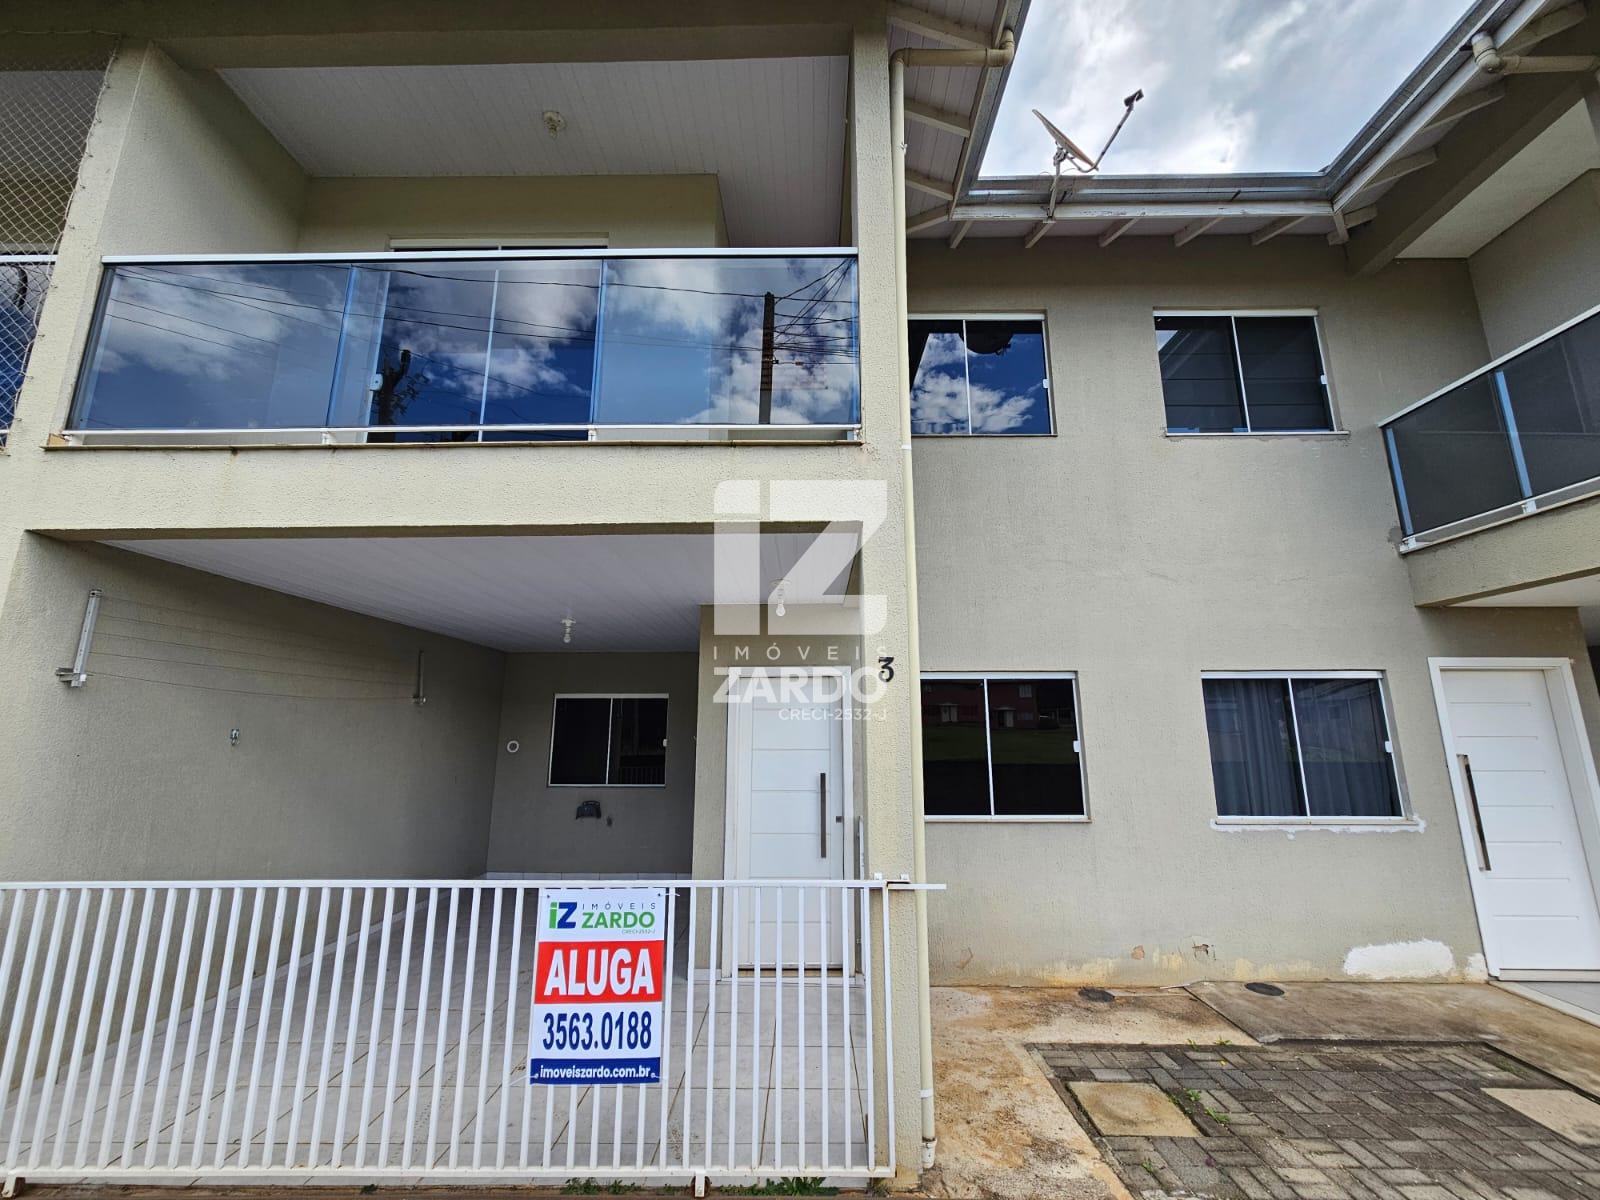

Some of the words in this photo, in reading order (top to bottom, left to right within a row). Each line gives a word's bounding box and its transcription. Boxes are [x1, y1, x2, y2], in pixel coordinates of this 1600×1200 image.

[878, 656, 895, 682] 3
[582, 902, 656, 910] IMÓVEIS
[581, 912, 655, 929] ZARDO
[543, 948, 655, 996] ALUGA
[542, 1011, 652, 1050] 3563.0188
[539, 1065, 651, 1079] imoveiszardo.com.br
